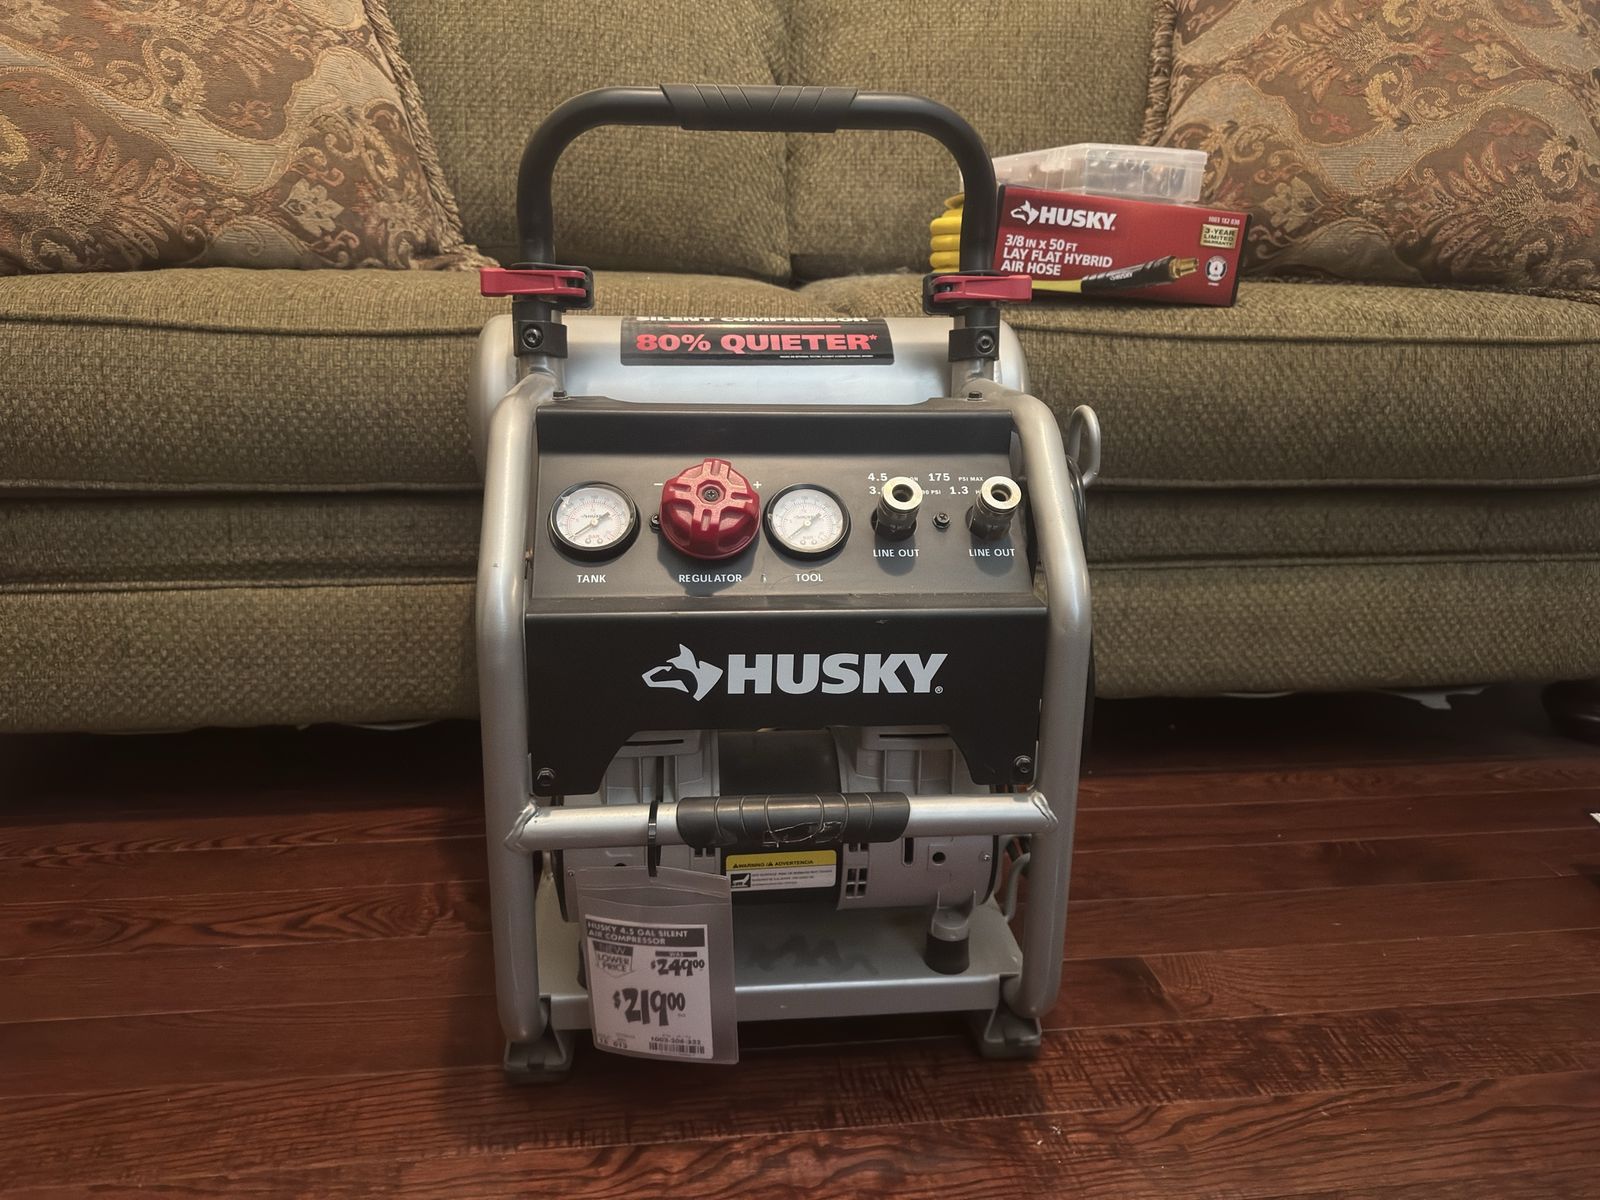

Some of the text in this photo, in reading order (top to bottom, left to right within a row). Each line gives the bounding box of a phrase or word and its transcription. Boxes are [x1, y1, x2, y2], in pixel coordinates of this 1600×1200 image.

[1039, 206, 1117, 231] HUSKY
[1203, 233, 1234, 242] LIMITED
[1204, 227, 1235, 236] 3-YEAR
[1004, 234, 1025, 248] 3/8
[1025, 238, 1037, 248] IN
[1048, 238, 1066, 251] 50
[1065, 242, 1078, 252] FT
[1003, 247, 1113, 269] LAY FLAT HYBRID
[1000, 259, 1062, 276] AIR HOSE
[636, 333, 712, 352] 80%
[867, 472, 888, 482] 4.5
[928, 472, 951, 482] 175
[868, 485, 885, 495] 3.
[949, 485, 969, 495] 1.3
[872, 548, 920, 558] LINE OUT
[968, 548, 1016, 557] LINE OUT
[576, 573, 607, 584] TANK
[678, 573, 743, 584] REGULATOR
[795, 573, 824, 583] TOOL
[727, 653, 948, 695] HUSKY
[774, 859, 814, 867] ADVERTENCIA
[587, 921, 689, 938] HUSKY 4.5 GAL SILENT
[588, 929, 666, 945] AIR COMPRESSOR
[597, 952, 630, 965] LOWER
[602, 960, 627, 973] PRICE
